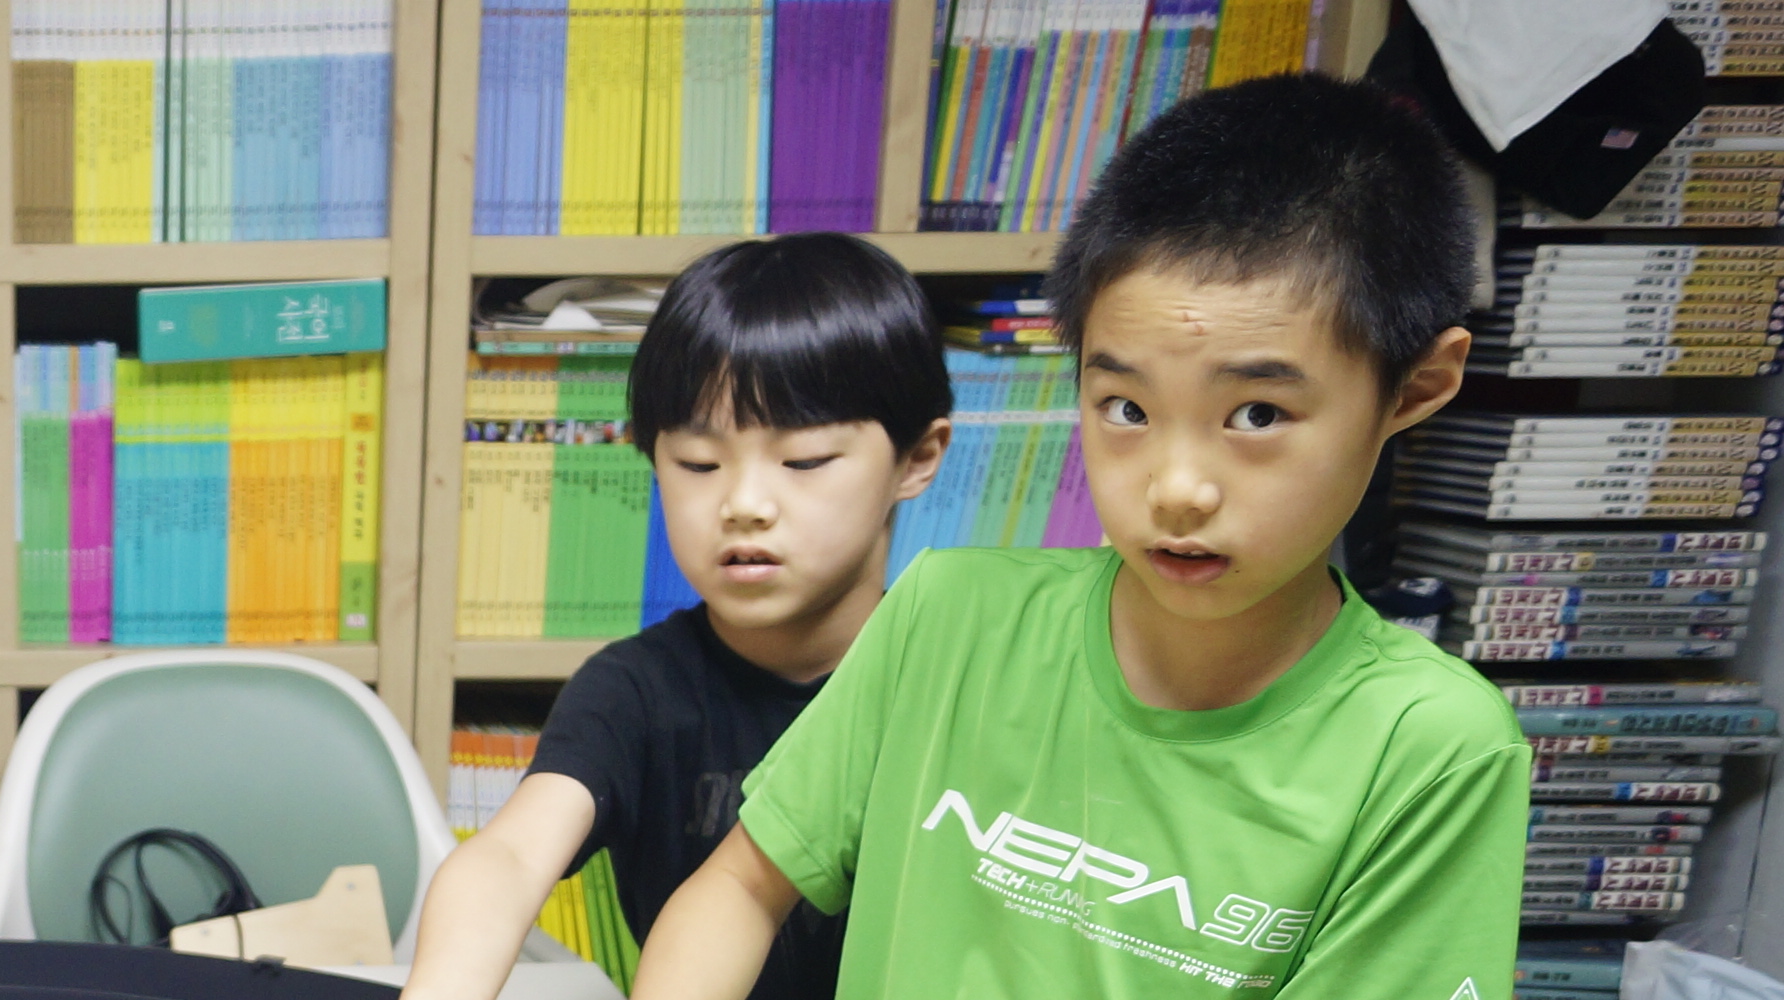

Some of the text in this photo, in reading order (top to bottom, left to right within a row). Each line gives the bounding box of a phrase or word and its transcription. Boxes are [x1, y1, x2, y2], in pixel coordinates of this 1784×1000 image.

[276, 295, 304, 343] 사전
[304, 293, 330, 340] 국어
[922, 789, 1314, 954] NEPA 96
[1179, 961, 1204, 977] HIT
